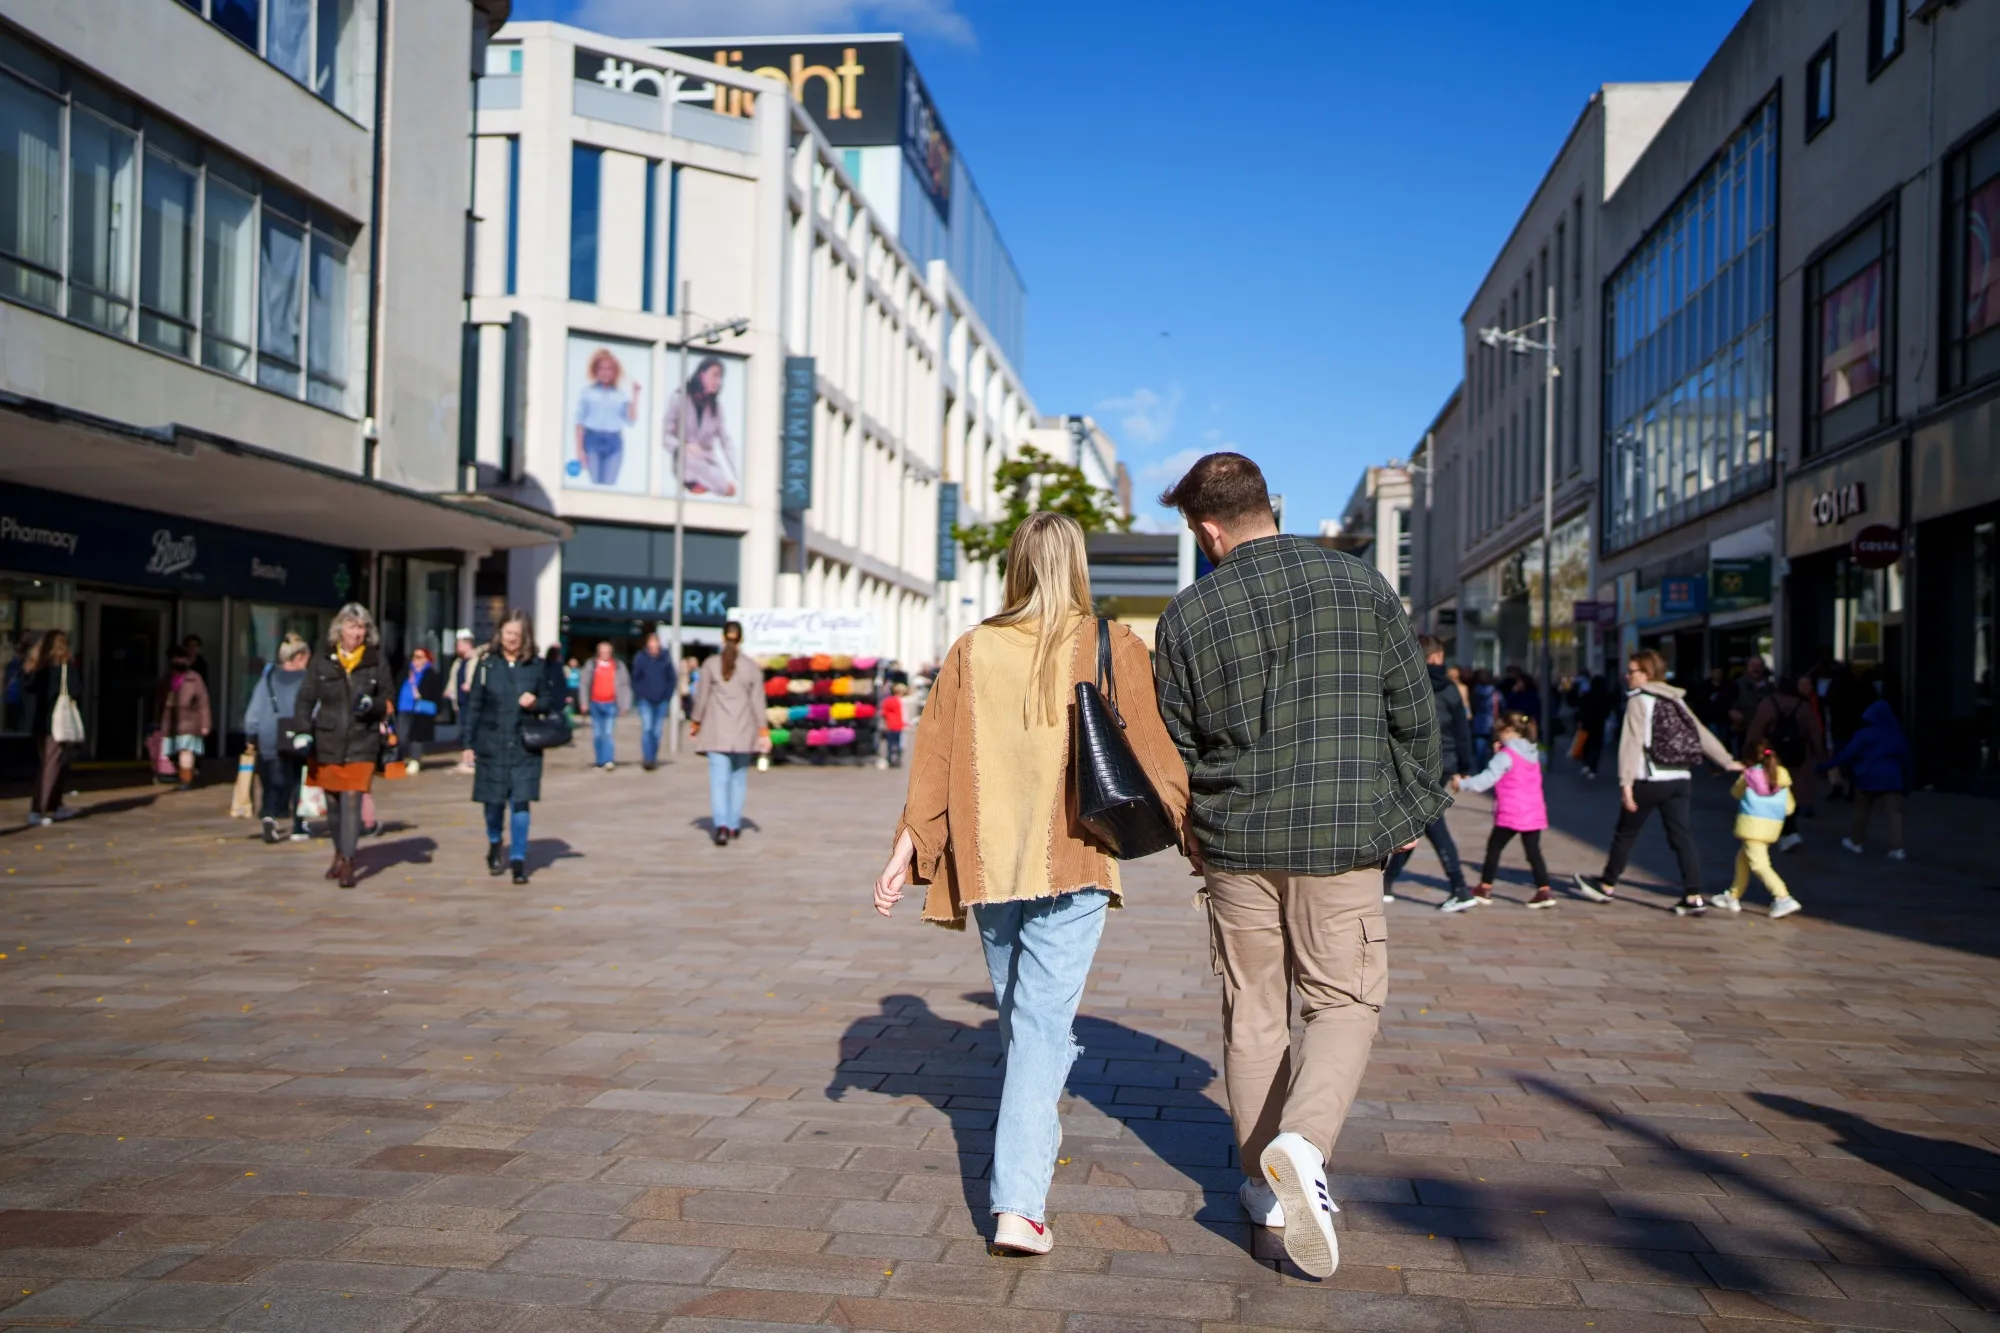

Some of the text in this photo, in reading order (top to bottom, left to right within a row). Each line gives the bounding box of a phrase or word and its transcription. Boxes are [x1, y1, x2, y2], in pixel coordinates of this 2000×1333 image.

[786, 369, 811, 497] PRIMARK
[1811, 483, 1861, 526] COSTA
[1, 516, 78, 556] Pharmacy
[146, 529, 198, 576] Boots
[568, 582, 728, 616] PRIMARK
